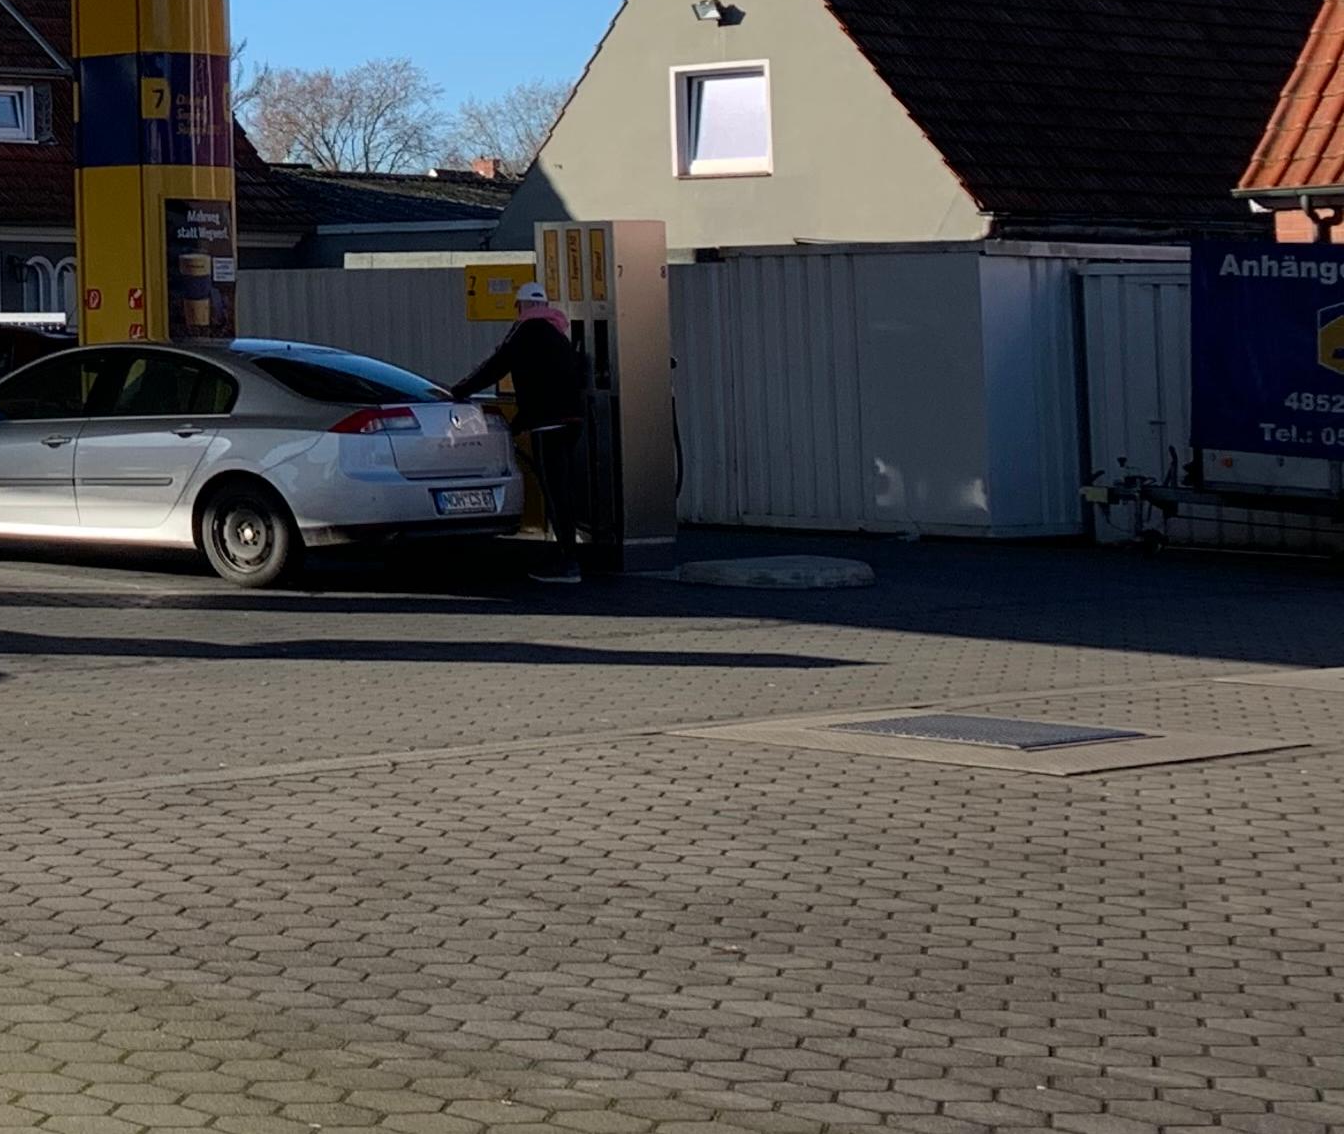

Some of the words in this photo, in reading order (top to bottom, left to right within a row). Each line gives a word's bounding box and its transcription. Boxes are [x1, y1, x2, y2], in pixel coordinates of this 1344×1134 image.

[152, 89, 164, 108] 7
[618, 266, 623, 278] 7
[661, 266, 666, 278] 8
